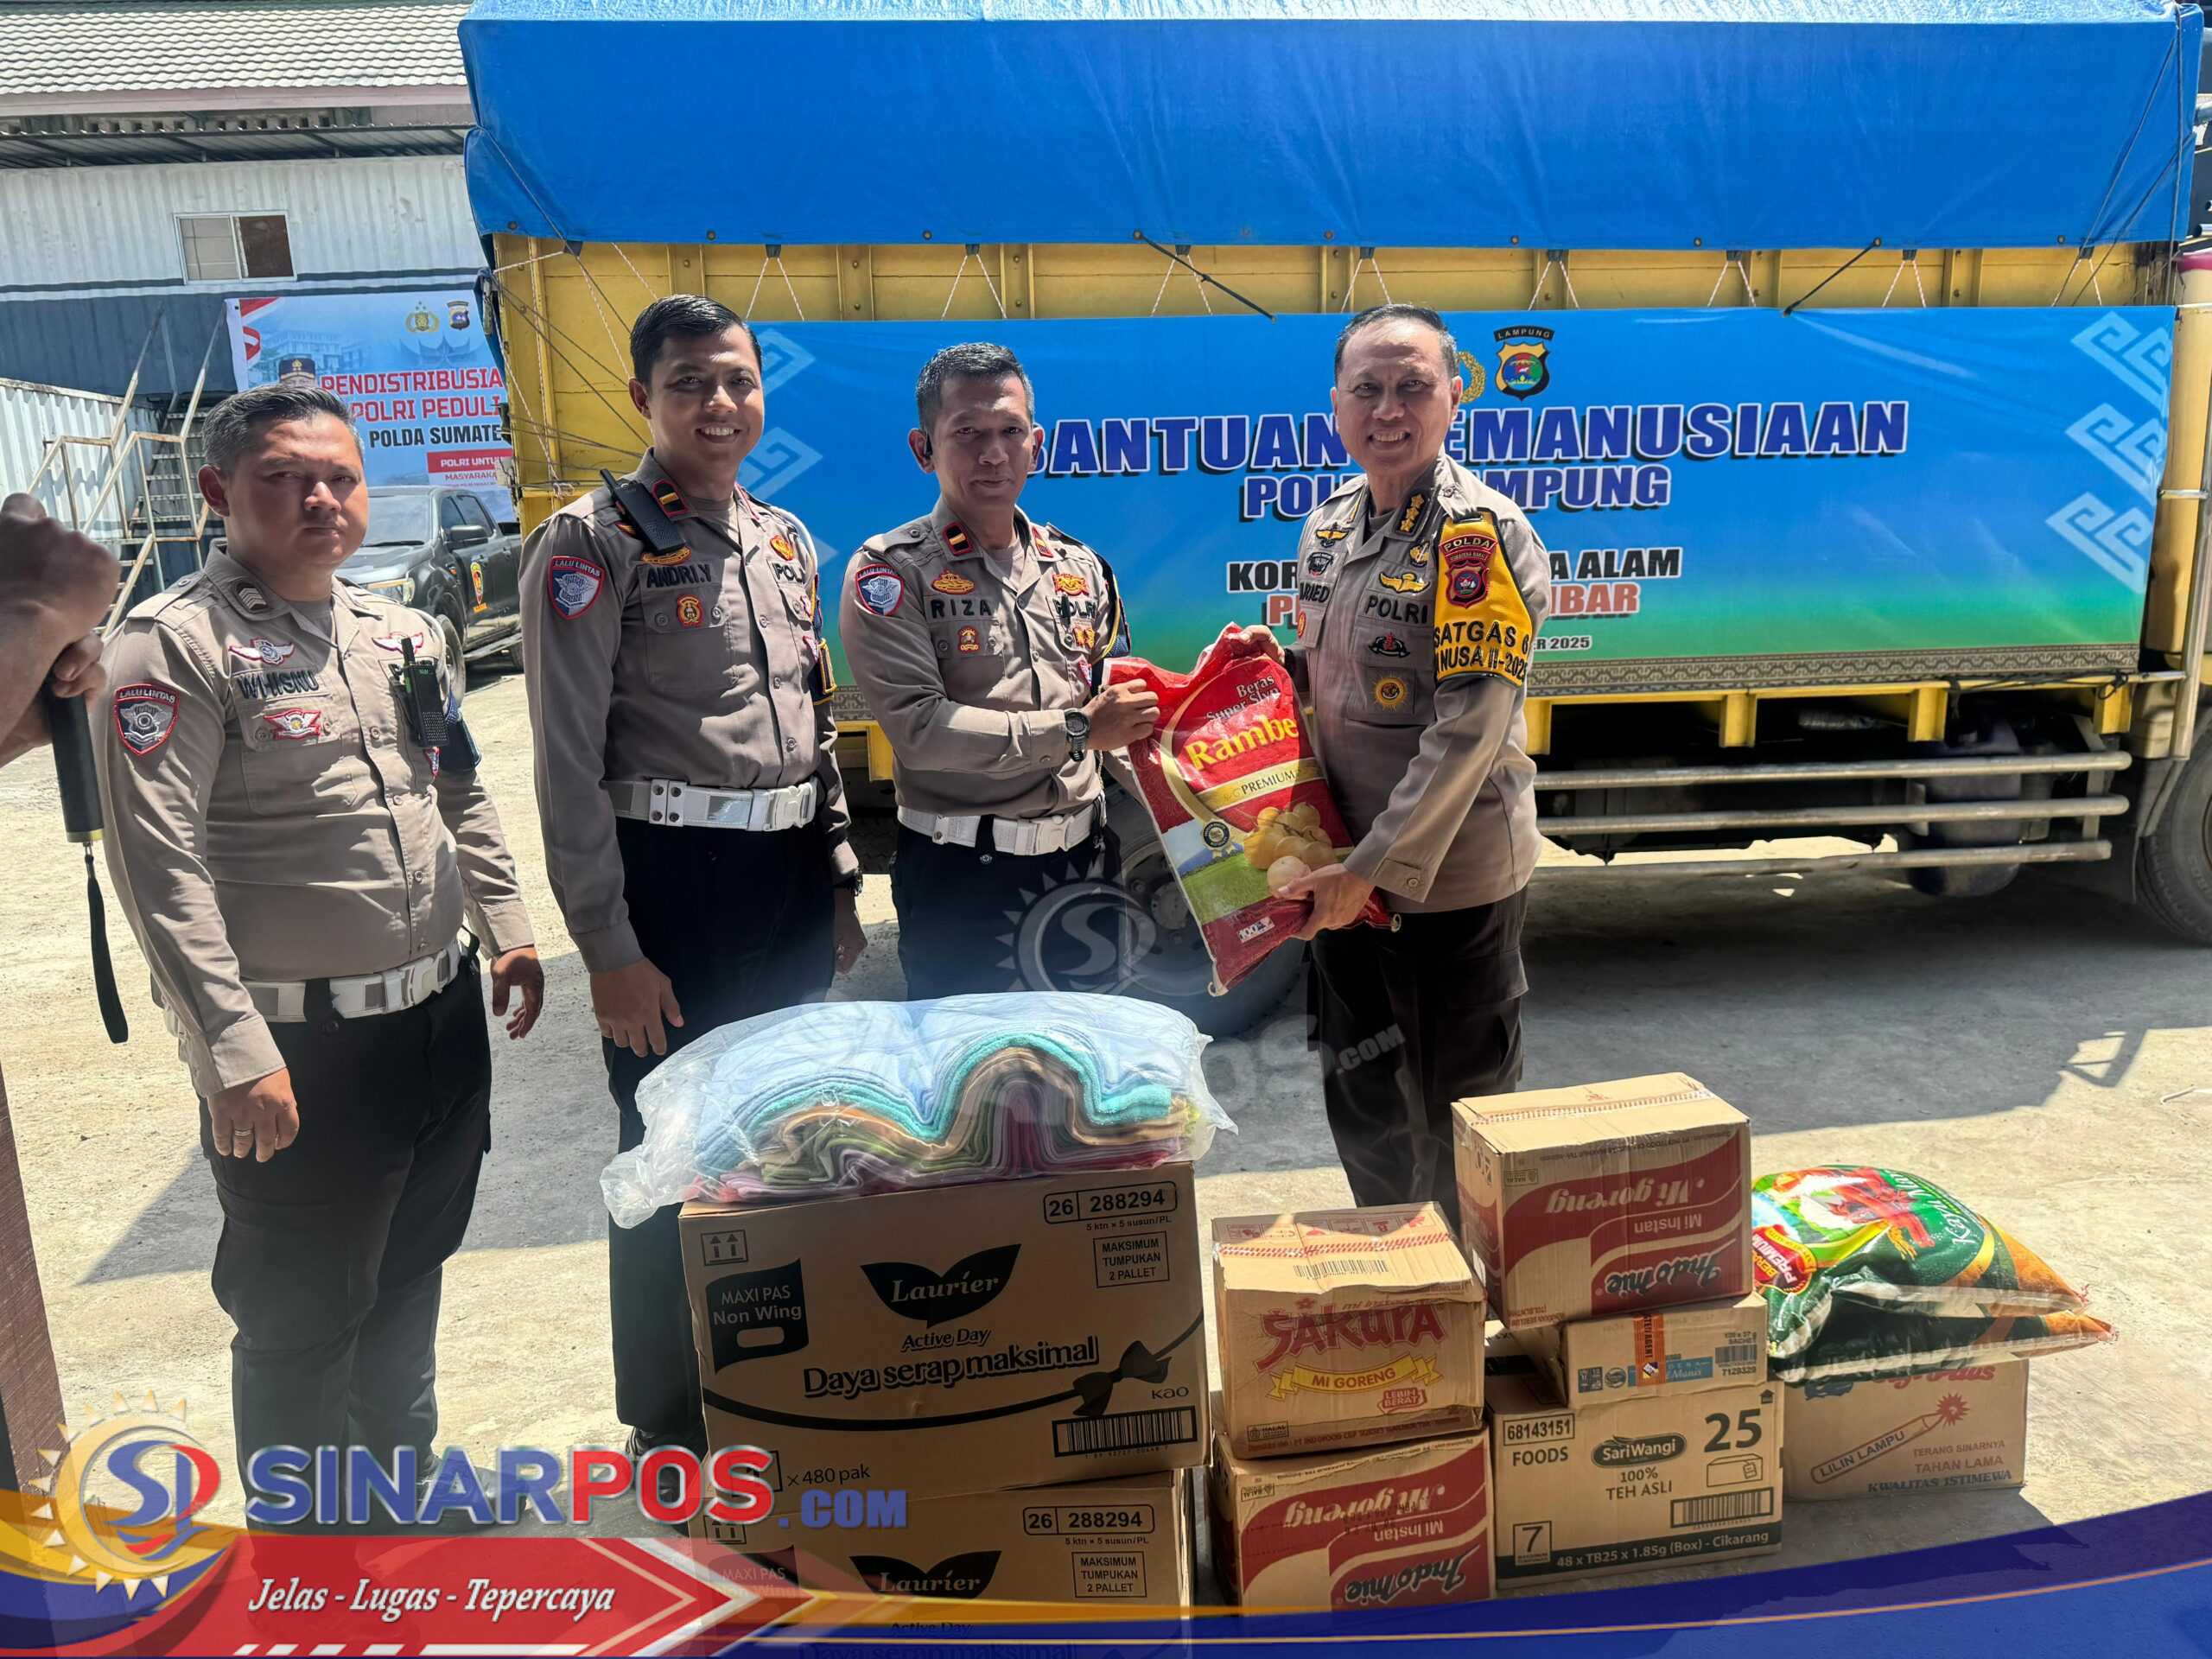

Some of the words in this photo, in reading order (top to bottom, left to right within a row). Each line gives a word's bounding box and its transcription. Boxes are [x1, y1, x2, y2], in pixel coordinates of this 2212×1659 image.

[1497, 327, 1551, 340] LAMPUNG
[350, 399, 415, 422] POLRI
[423, 396, 500, 418] PEDULI
[370, 429, 424, 448] POLDA
[1028, 415, 1351, 474] ANTUAN
[1445, 401, 1909, 463] EMANUSIAAN
[442, 459, 469, 467] POLRI
[446, 472, 497, 481] MASYARAKA
[1444, 537, 1491, 552] POLDA
[772, 563, 803, 583] POL
[1576, 547, 1682, 580] ALAM
[931, 599, 992, 619] RIZA
[1364, 594, 1427, 623] POLRI
[1433, 620, 1517, 648] SATGAS
[1550, 636, 1591, 650] 2025
[237, 670, 320, 700] WHISNU
[1236, 675, 1274, 698] Beras
[143, 689, 175, 703] LINTAS
[1206, 700, 1246, 720] Super
[1241, 769, 1296, 795] PREMIUM
[1048, 1198, 1074, 1217] 26
[1090, 1189, 1166, 1212] 288294
[1546, 1178, 1653, 1214] goreng
[1635, 1217, 1681, 1234] Instan
[1686, 1213, 1702, 1228] Mi
[1102, 1237, 1160, 1253] MAKSIMUM
[1103, 1252, 1161, 1267] TUMPUKAN
[1753, 1249, 1778, 1279] BERA
[1109, 1271, 1116, 1281] 2
[1118, 1267, 1156, 1280] PALLET
[721, 1287, 759, 1306] MAXI
[763, 1285, 791, 1301] PAS
[890, 1270, 999, 1303] Laurier
[713, 1308, 750, 1325] Non
[755, 1305, 803, 1321] Wing
[900, 1330, 955, 1353] Active
[956, 1328, 992, 1346] Day
[804, 1366, 880, 1400] Daya
[882, 1357, 963, 1389] serap
[963, 1335, 1099, 1380] maksimal
[1312, 1374, 1330, 1389] MI
[1333, 1368, 1396, 1389] GORENG
[1384, 1396, 1418, 1408] BERAT
[1507, 1420, 1571, 1440] 68143151
[1703, 1408, 1764, 1453] 25
[1512, 1446, 1568, 1467] FOODS
[1602, 1438, 1676, 1462] SariWangi
[1820, 1455, 1855, 1477] LILIN
[1857, 1431, 1905, 1459] LAMPU
[1913, 1445, 1954, 1458] TERANG
[1956, 1440, 2005, 1453] SINARNYA
[803, 1467, 836, 1484] 480
[839, 1464, 871, 1484] pak
[1620, 1466, 1658, 1483] 100%
[1915, 1459, 1961, 1474] TAHAN
[1965, 1455, 2004, 1469] LAMA
[1605, 1485, 1637, 1501] TEH
[1642, 1481, 1673, 1496] ASLI
[1867, 1477, 1941, 1493] KWALITAS
[1944, 1470, 2012, 1487] ISTIMEWA
[1283, 1486, 1395, 1528] goreng
[1028, 1514, 1052, 1529] 26
[1068, 1511, 1143, 1528] 288294
[1427, 1520, 1444, 1535] Mi
[1374, 1523, 1423, 1543] Instan
[1522, 1525, 1544, 1554] 7
[1556, 1555, 1573, 1568] 48
[1576, 1556, 1584, 1566] x
[1586, 1550, 1618, 1565] TB25
[1620, 1551, 1629, 1560] x
[1631, 1543, 1667, 1560] 1.85g
[1669, 1537, 1703, 1555] (Box)
[1713, 1531, 1770, 1548] Cikarang
[1080, 1556, 1137, 1567] MAKSIMUM
[721, 1568, 758, 1580] MAXI
[760, 1567, 786, 1580] PAS
[877, 1569, 981, 1592] Laurier
[1082, 1569, 1138, 1580] TUMPUKAN
[1086, 1583, 1093, 1592] 2
[1096, 1582, 1134, 1593] PALLET
